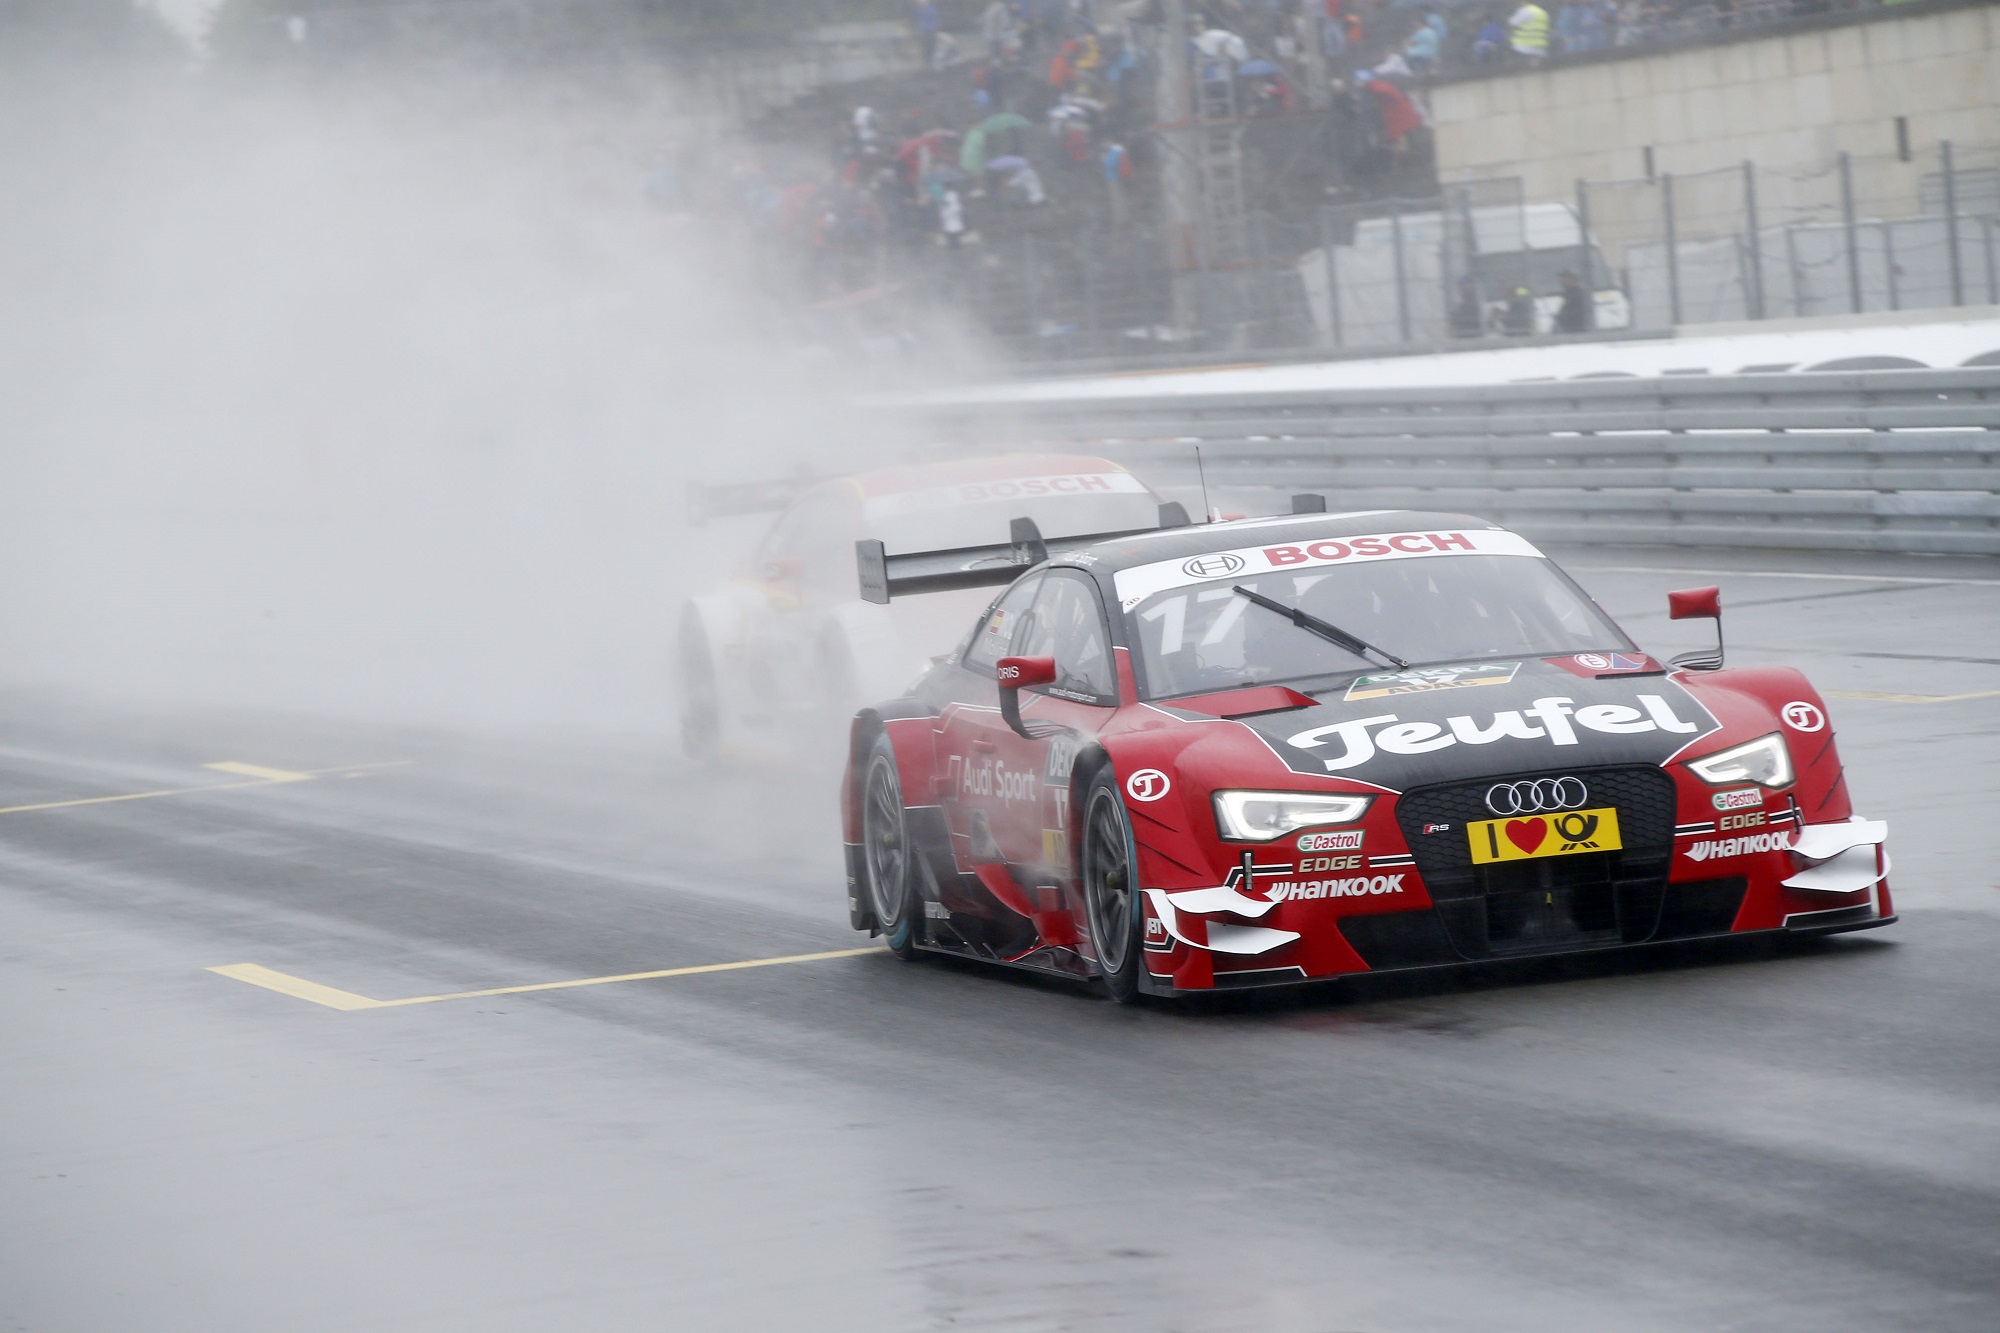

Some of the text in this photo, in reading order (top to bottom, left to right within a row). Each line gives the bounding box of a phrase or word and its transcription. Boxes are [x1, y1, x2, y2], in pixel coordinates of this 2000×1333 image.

[959, 476, 1112, 501] BOSCH
[1261, 533, 1477, 567] BOSCH
[1141, 583, 1258, 656] 17
[1367, 665, 1509, 683] DEKRA
[1388, 679, 1478, 695] ADAC
[1287, 694, 1699, 772] Teufel
[1050, 742, 1073, 777] DEK
[963, 757, 1036, 809] Audi Sport
[1726, 789, 1762, 808] Castrol
[1428, 823, 1450, 832] RS
[1719, 811, 1767, 831] EDGE
[1313, 832, 1360, 850] Castrol
[1486, 823, 1500, 859] I
[1298, 854, 1364, 873] EDGE
